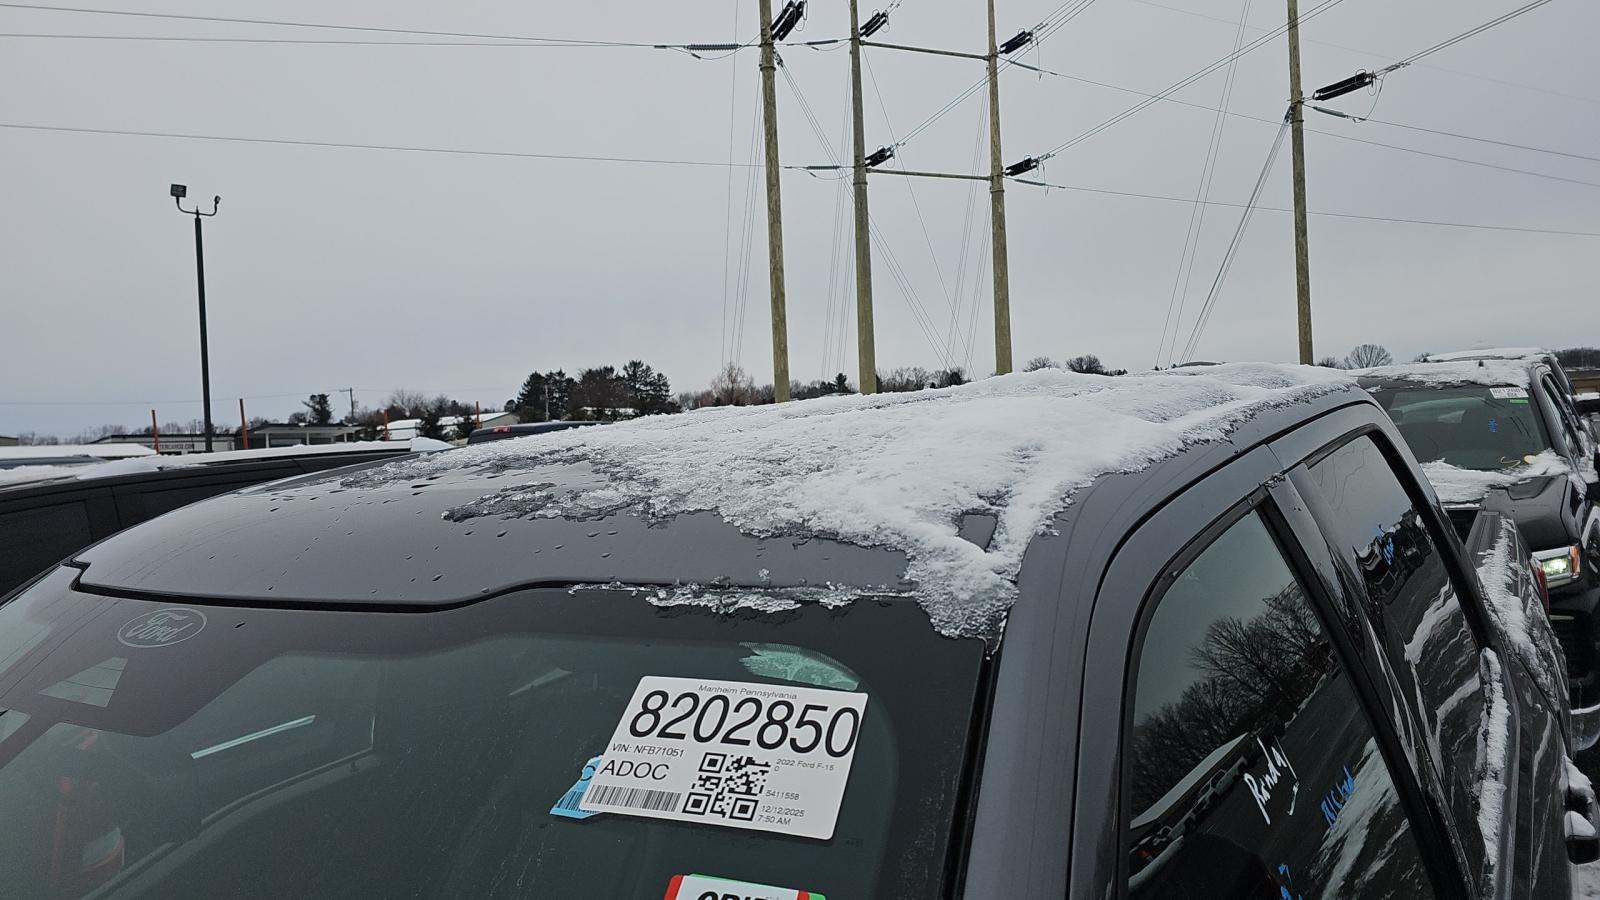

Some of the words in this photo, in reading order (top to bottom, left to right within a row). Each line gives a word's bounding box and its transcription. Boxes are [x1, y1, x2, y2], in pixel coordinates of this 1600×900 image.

[123, 610, 195, 643] Ford
[699, 684, 737, 695] Manheim
[740, 687, 798, 700] Pennsylvania
[629, 689, 860, 759] 8202850
[612, 743, 632, 753] VIN:
[634, 744, 685, 757] NFB71051
[600, 759, 670, 781] ADOC
[776, 758, 795, 767] 2022
[797, 760, 815, 769] Ford
[816, 762, 835, 771] F-15
[761, 805, 805, 817] 12/12/2025
[758, 814, 776, 824] 7:50
[776, 817, 792, 827] AM
